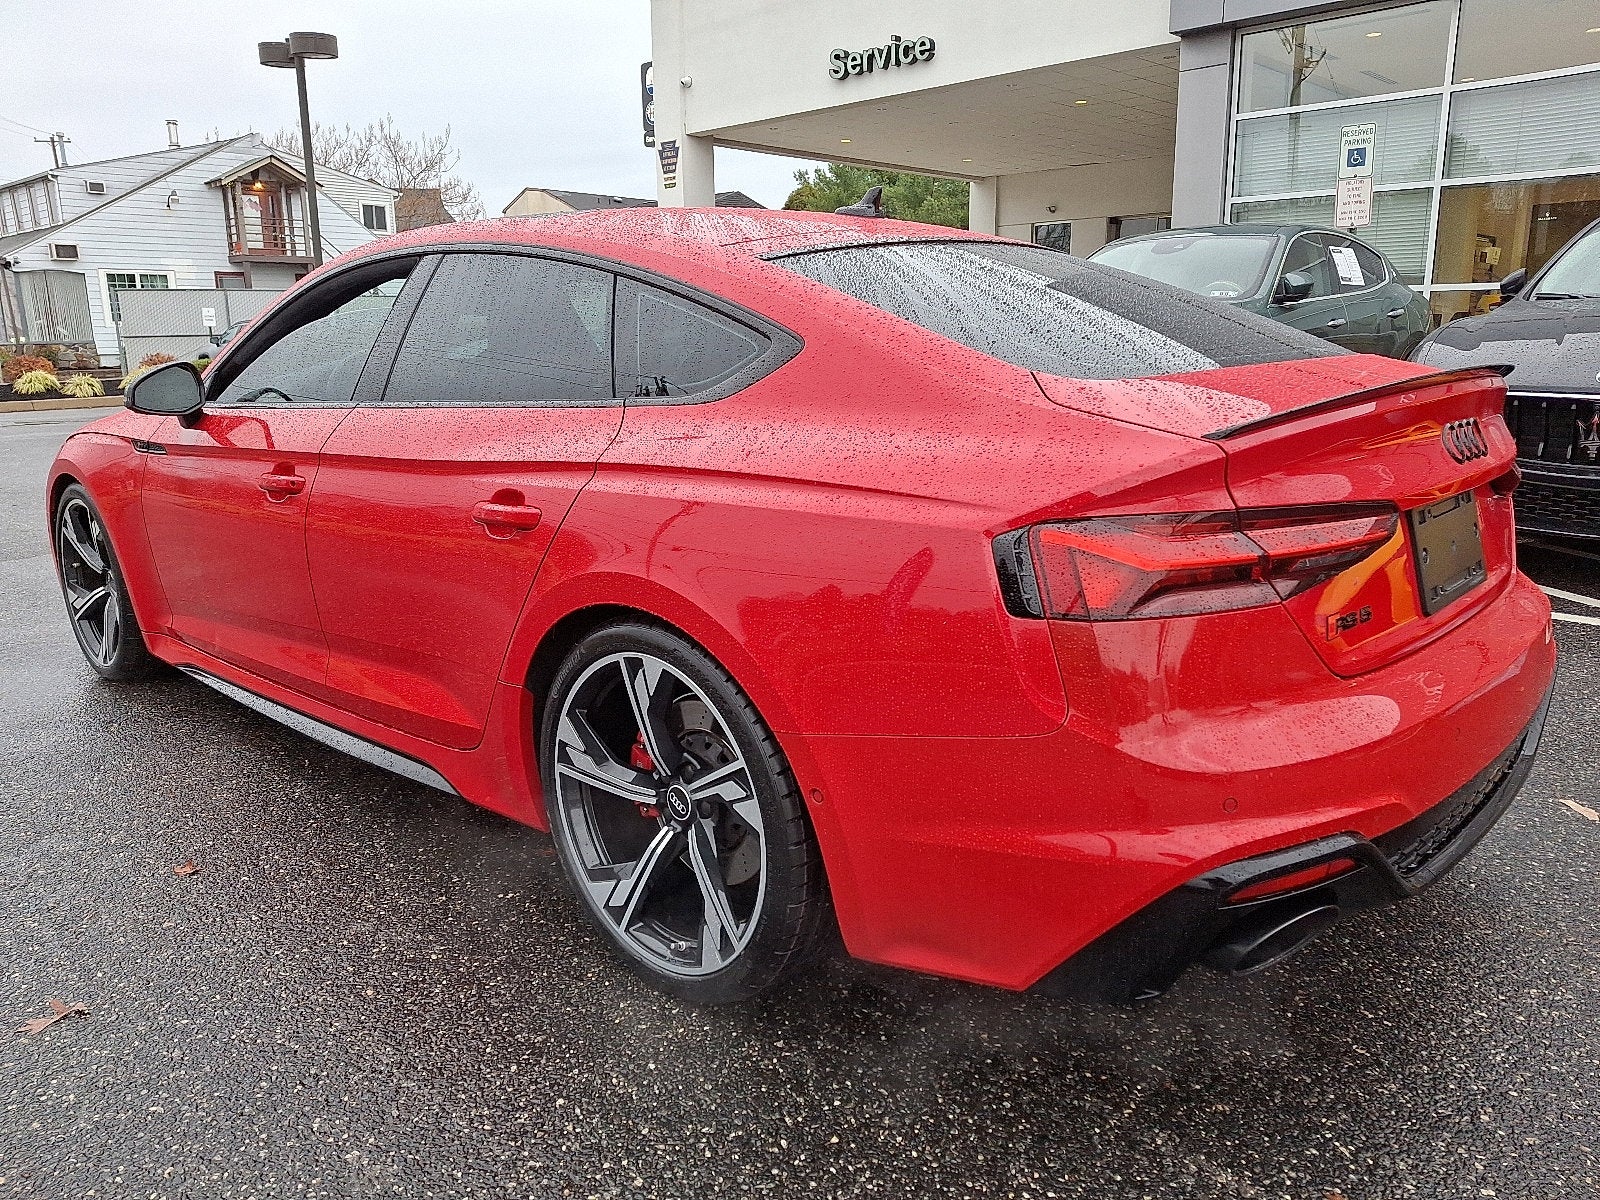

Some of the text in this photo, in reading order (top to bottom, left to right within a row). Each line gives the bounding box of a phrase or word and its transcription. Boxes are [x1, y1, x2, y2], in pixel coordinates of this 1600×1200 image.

[828, 34, 936, 80] Service
[1342, 127, 1374, 138] RESERVED
[1344, 137, 1372, 147] PARKING
